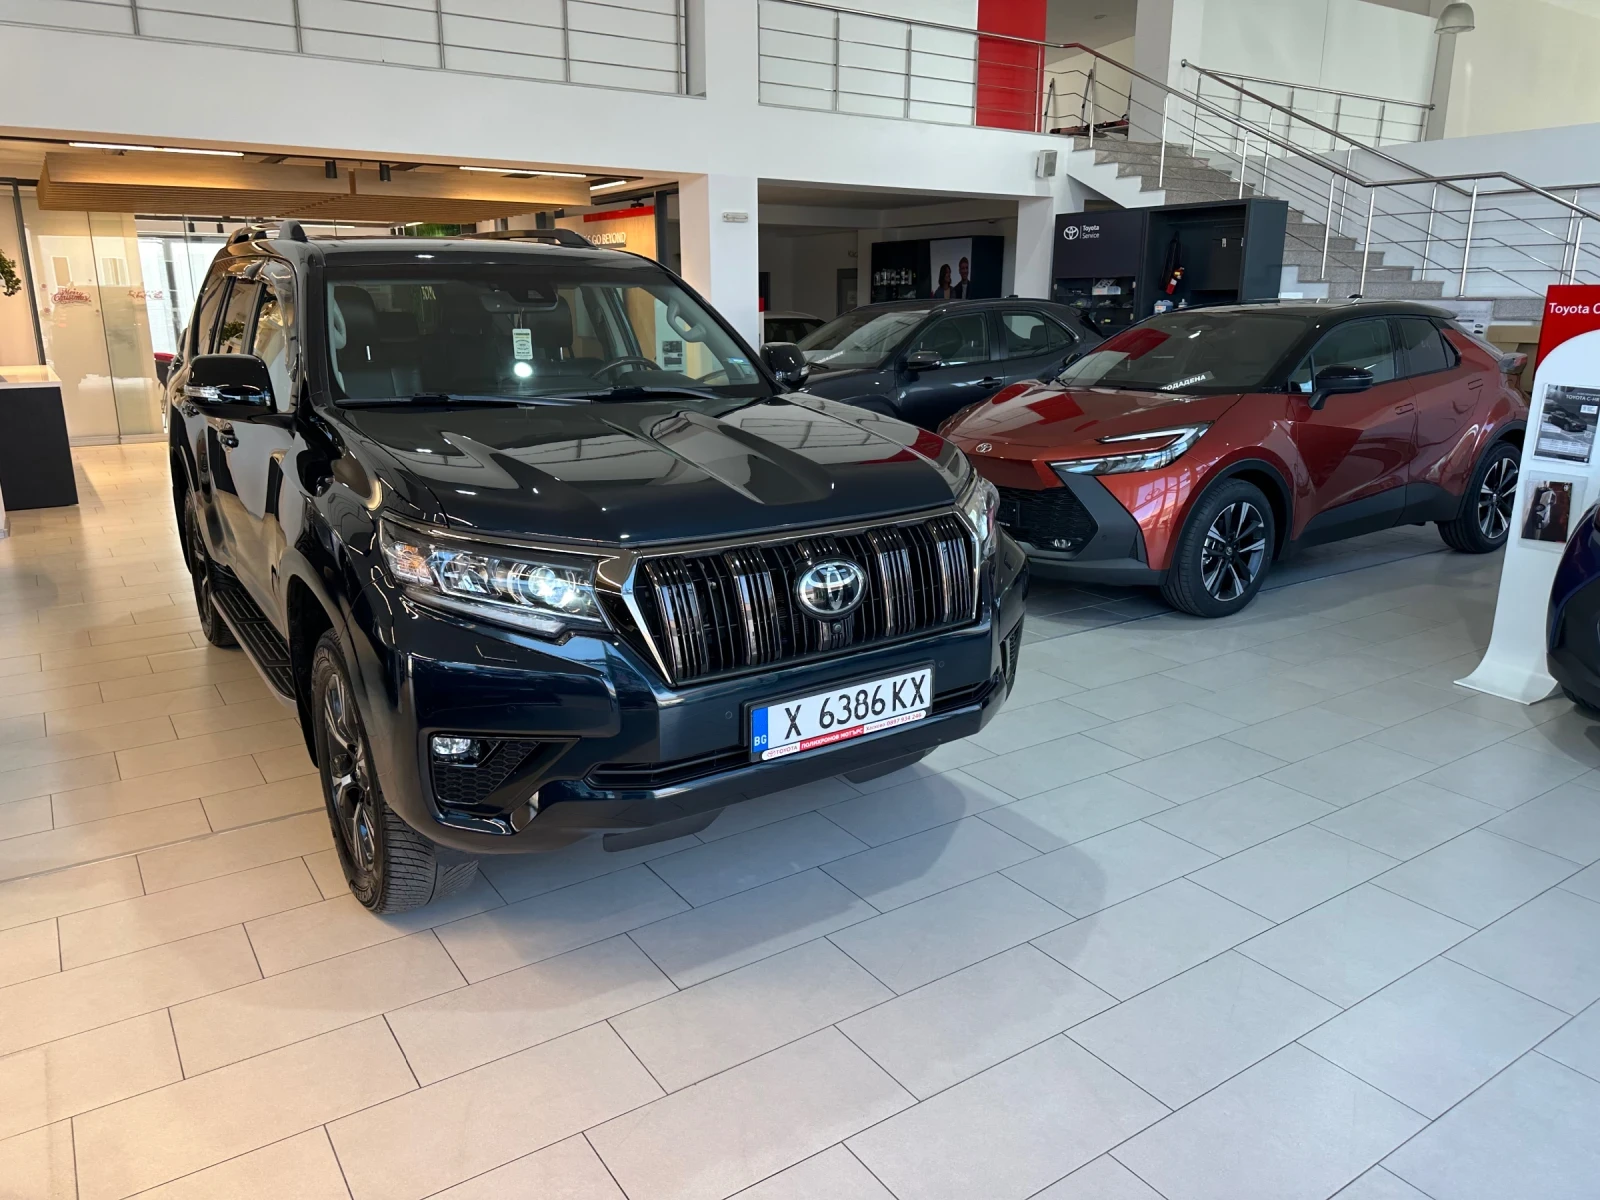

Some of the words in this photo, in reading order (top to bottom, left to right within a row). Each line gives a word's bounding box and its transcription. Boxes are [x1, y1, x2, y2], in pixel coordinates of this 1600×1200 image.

[592, 234, 601, 245] GO
[1549, 302, 1590, 316] Toyota
[1159, 374, 1206, 391] ОДАДЕНА
[785, 704, 802, 740] X
[819, 685, 886, 729] 6386
[754, 734, 767, 747] BG
[776, 745, 798, 755] TOYOTA
